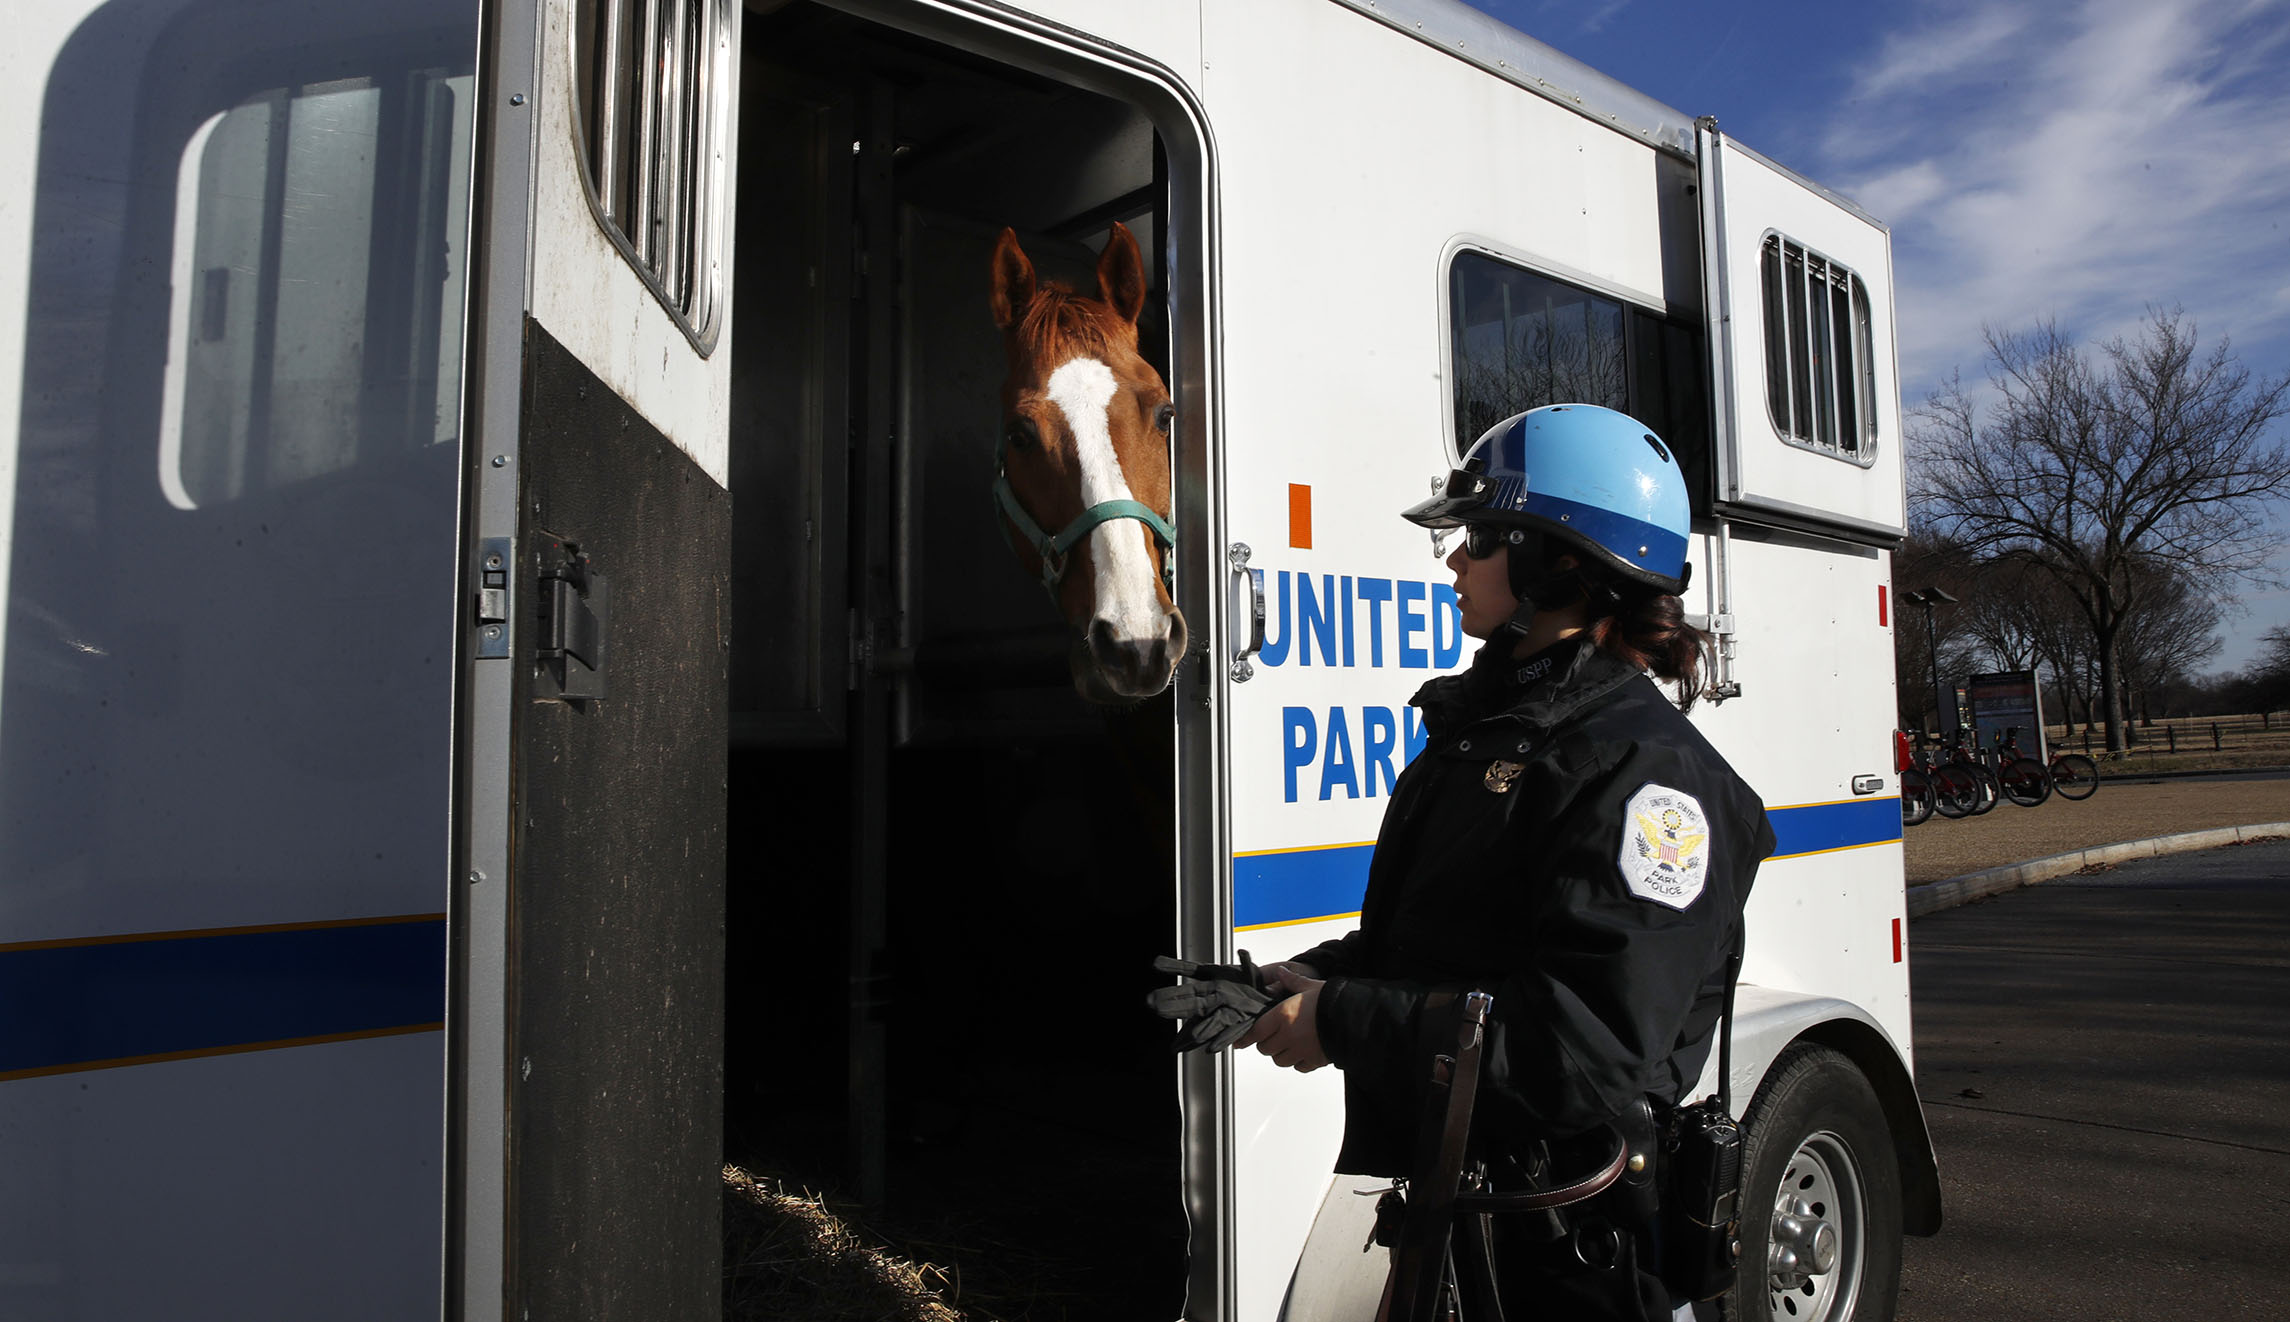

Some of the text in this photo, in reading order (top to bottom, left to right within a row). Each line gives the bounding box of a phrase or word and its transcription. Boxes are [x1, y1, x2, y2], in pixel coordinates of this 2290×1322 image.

[1250, 568, 1463, 669] UNITED
[1517, 657, 1552, 684] USPP
[1643, 876, 1682, 895] POLICE
[1651, 870, 1678, 884] PARK
